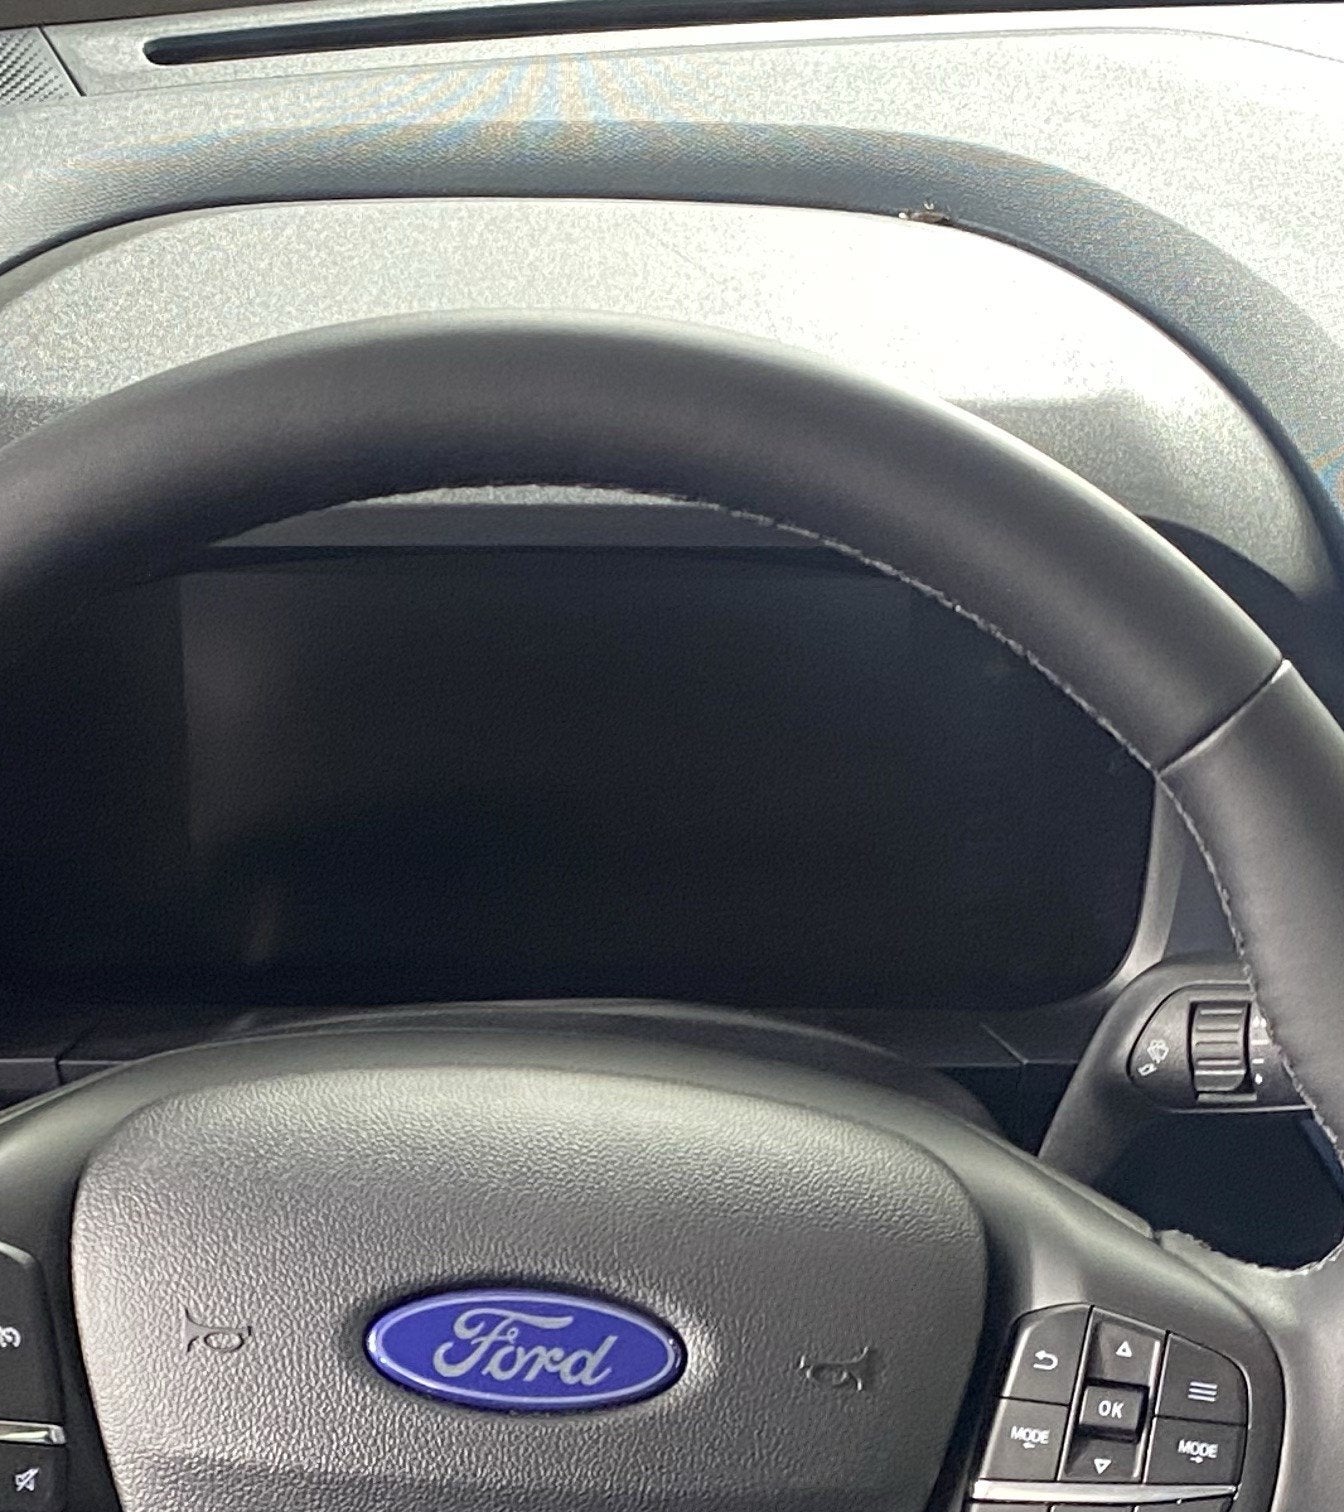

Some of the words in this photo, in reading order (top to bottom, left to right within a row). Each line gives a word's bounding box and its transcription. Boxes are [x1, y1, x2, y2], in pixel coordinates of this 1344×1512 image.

[433, 1307, 618, 1386] Ford
[1098, 1400, 1124, 1419] OK
[1010, 1425, 1050, 1445] MODE
[1177, 1439, 1219, 1459] MODE
